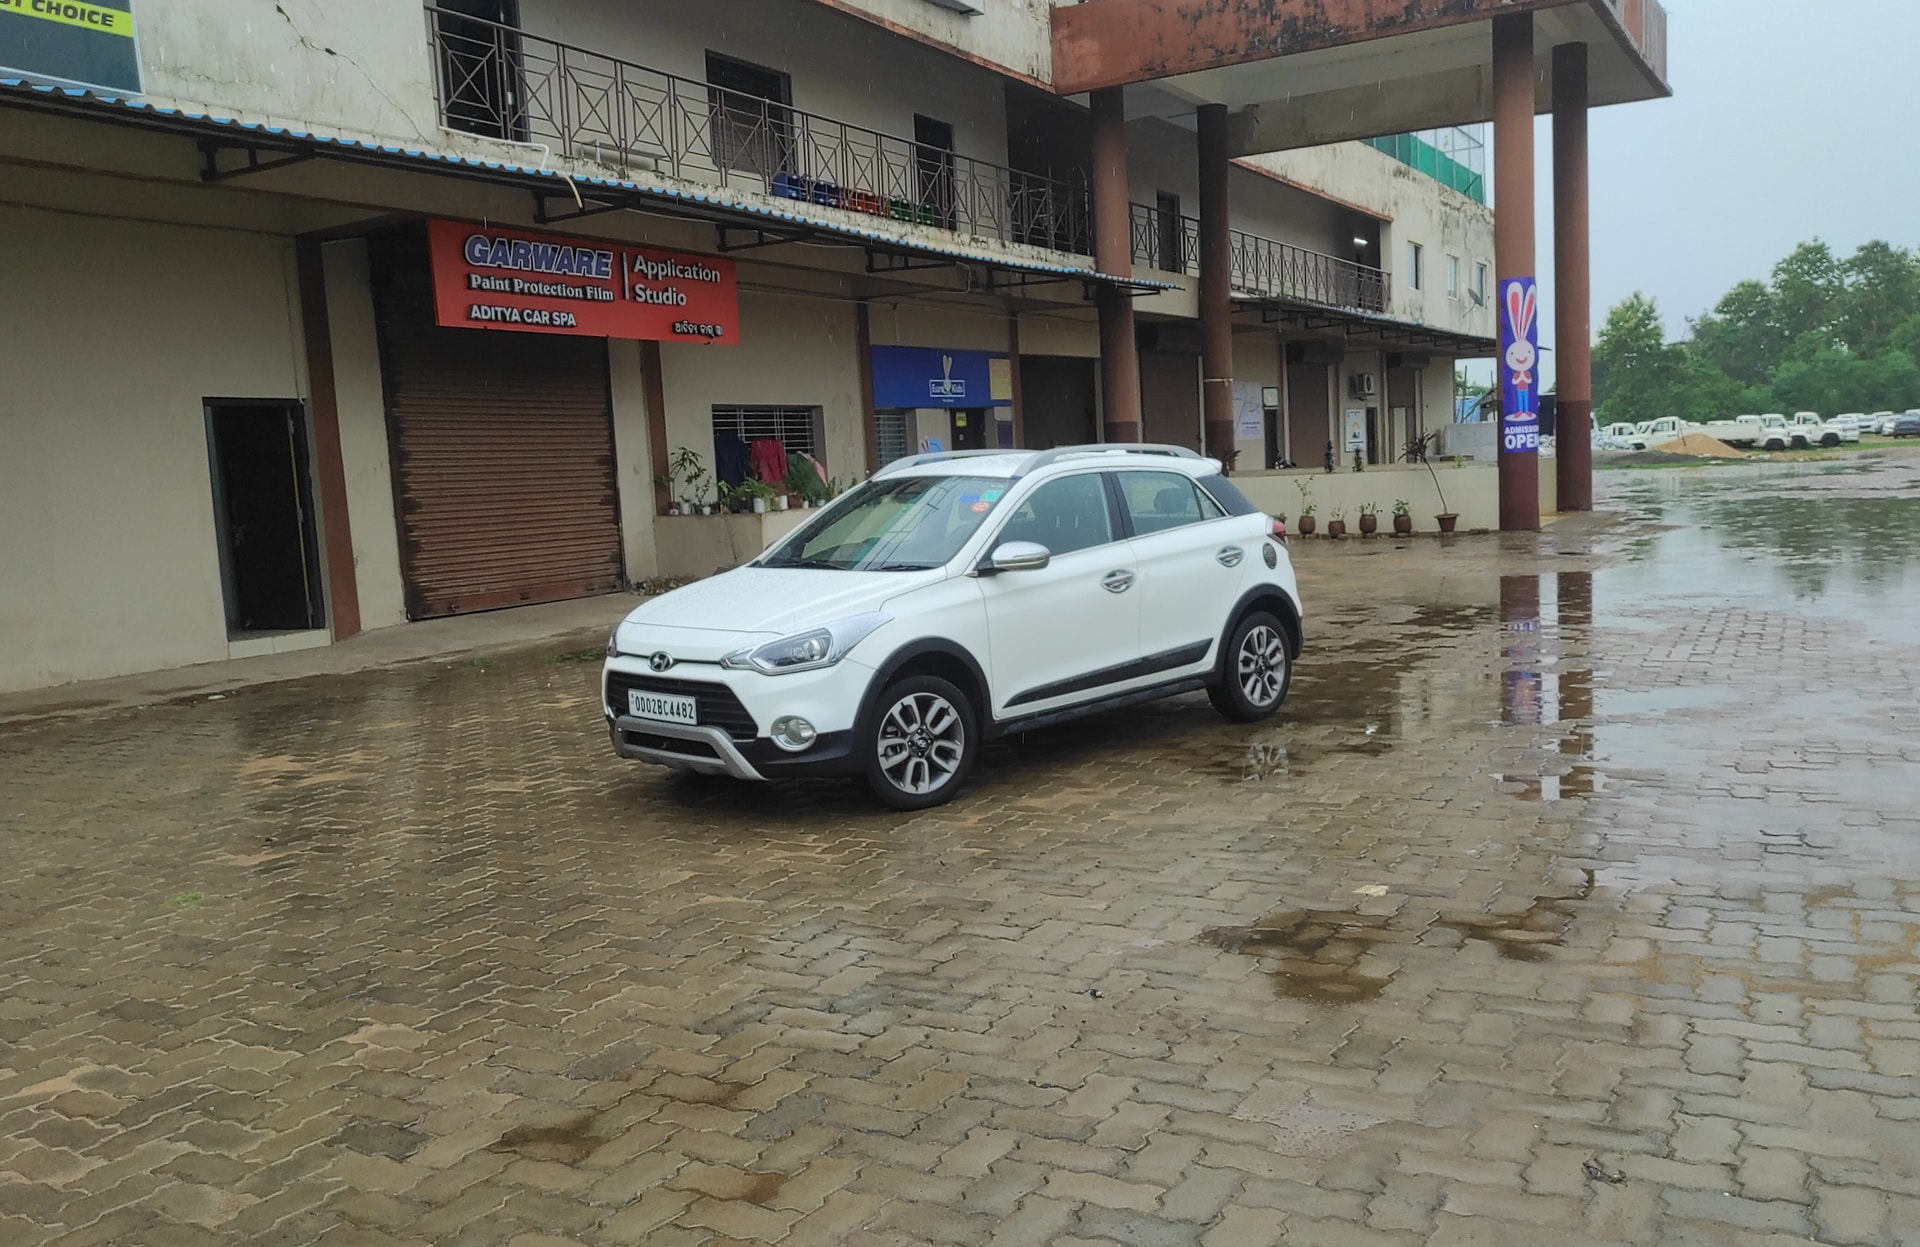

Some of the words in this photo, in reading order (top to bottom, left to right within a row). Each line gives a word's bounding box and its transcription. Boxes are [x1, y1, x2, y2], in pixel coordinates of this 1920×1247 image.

[31, 0, 114, 27] CHOICE
[465, 234, 613, 279] GARWARE
[634, 255, 720, 282] Application
[470, 274, 510, 291] Paint
[513, 278, 583, 299] Protection
[586, 286, 614, 301] Film
[635, 283, 687, 306] Studio
[471, 305, 521, 322] ADITYA
[523, 309, 550, 324] CAR
[552, 312, 577, 326] SPA
[635, 695, 693, 719] OD02BC4482
